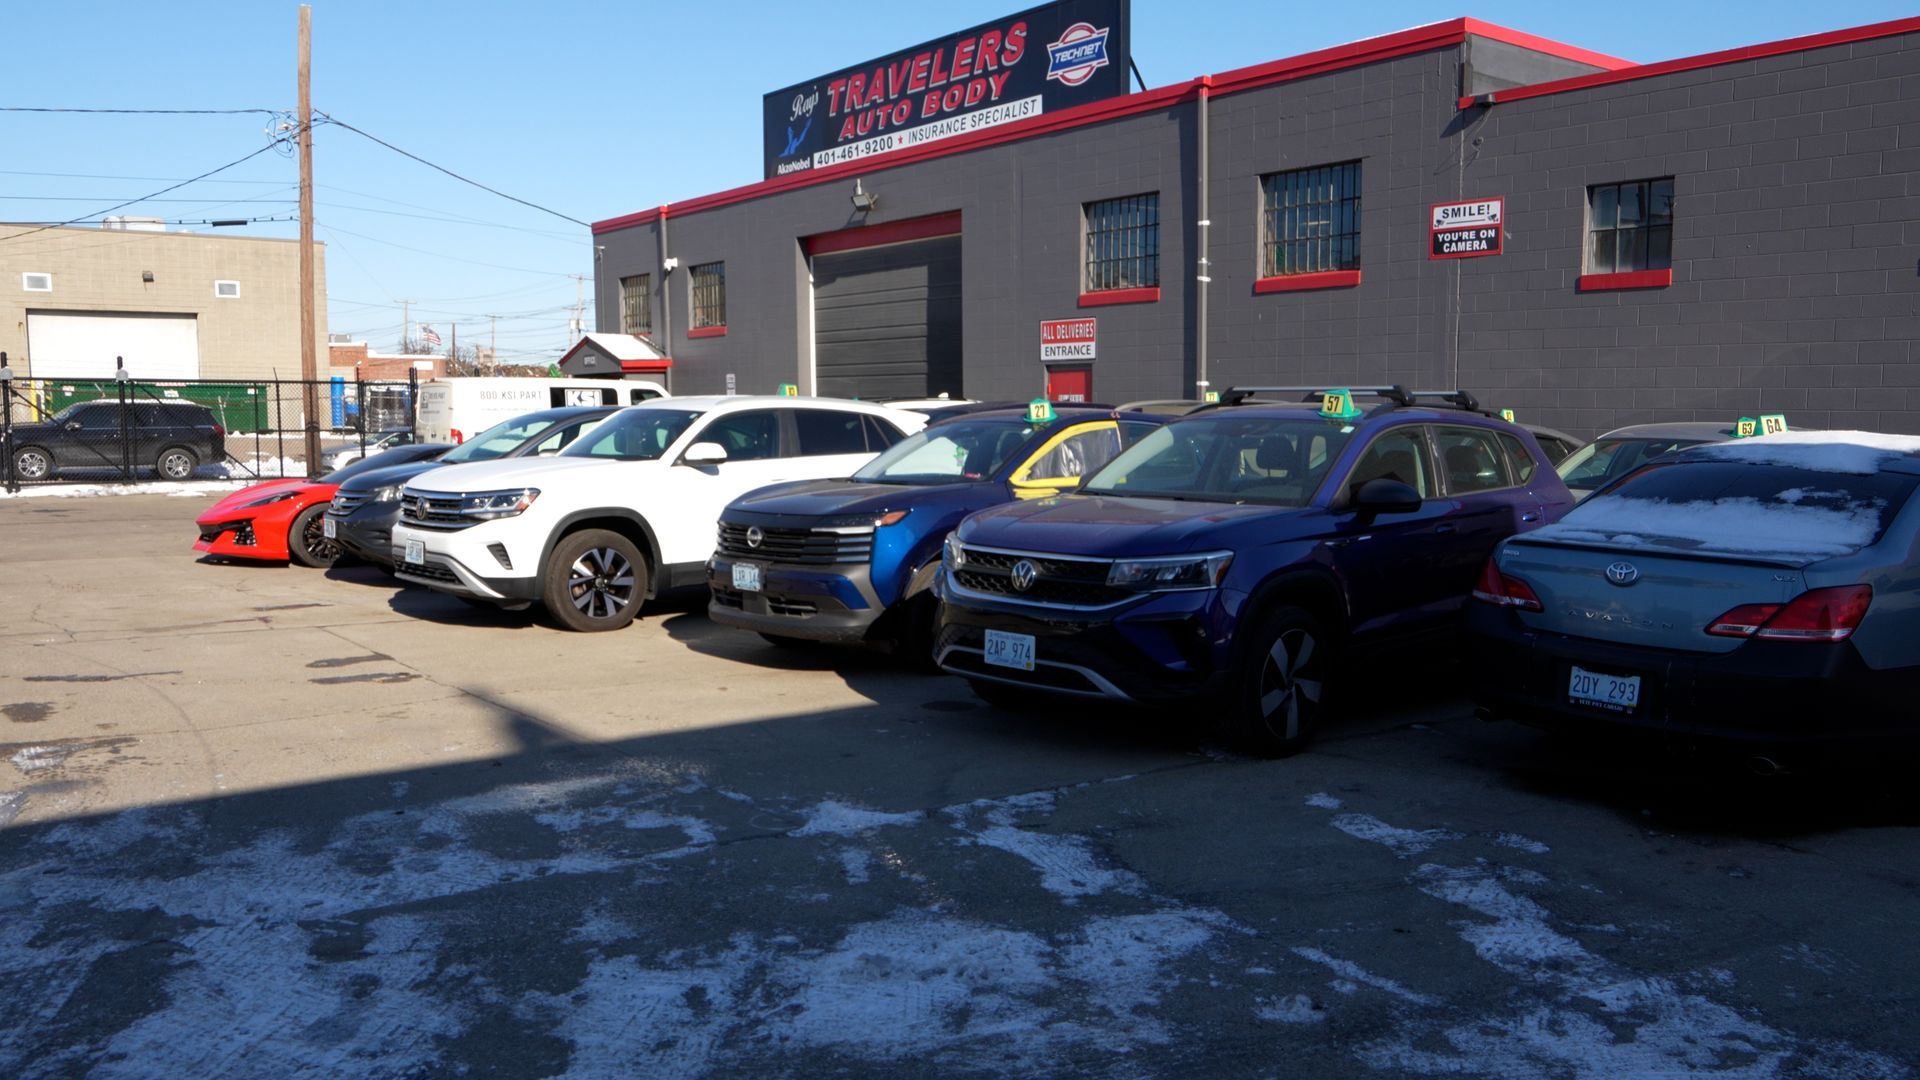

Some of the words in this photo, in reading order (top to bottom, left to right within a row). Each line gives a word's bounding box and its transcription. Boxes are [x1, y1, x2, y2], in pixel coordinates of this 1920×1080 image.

[827, 21, 1027, 117] TRAVELERS
[838, 99, 912, 142] AUTO
[921, 71, 1012, 118] BODY
[817, 136, 893, 165] 401-461-9200
[908, 118, 966, 144] INSURANCE
[971, 99, 1037, 128] SPECIALIST
[777, 157, 810, 175] AkzoNobel
[1442, 204, 1490, 219] SMILE!
[1437, 230, 1476, 242] YOU'RE
[1479, 229, 1496, 239] ON
[1443, 240, 1488, 253] CAMERA
[1042, 325, 1055, 340] ALL
[1056, 323, 1094, 340] DELIVERIES
[1045, 344, 1091, 357] ENTRANCE
[566, 390, 600, 407] KSI
[1327, 395, 1340, 412] 57
[1034, 404, 1046, 418] 27
[1742, 422, 1753, 435] 63
[1766, 418, 1782, 434] 64
[987, 639, 1006, 657] 2AP
[1012, 642, 1031, 660] 974
[1572, 674, 1600, 696] 2DY
[1607, 680, 1636, 702] 293
